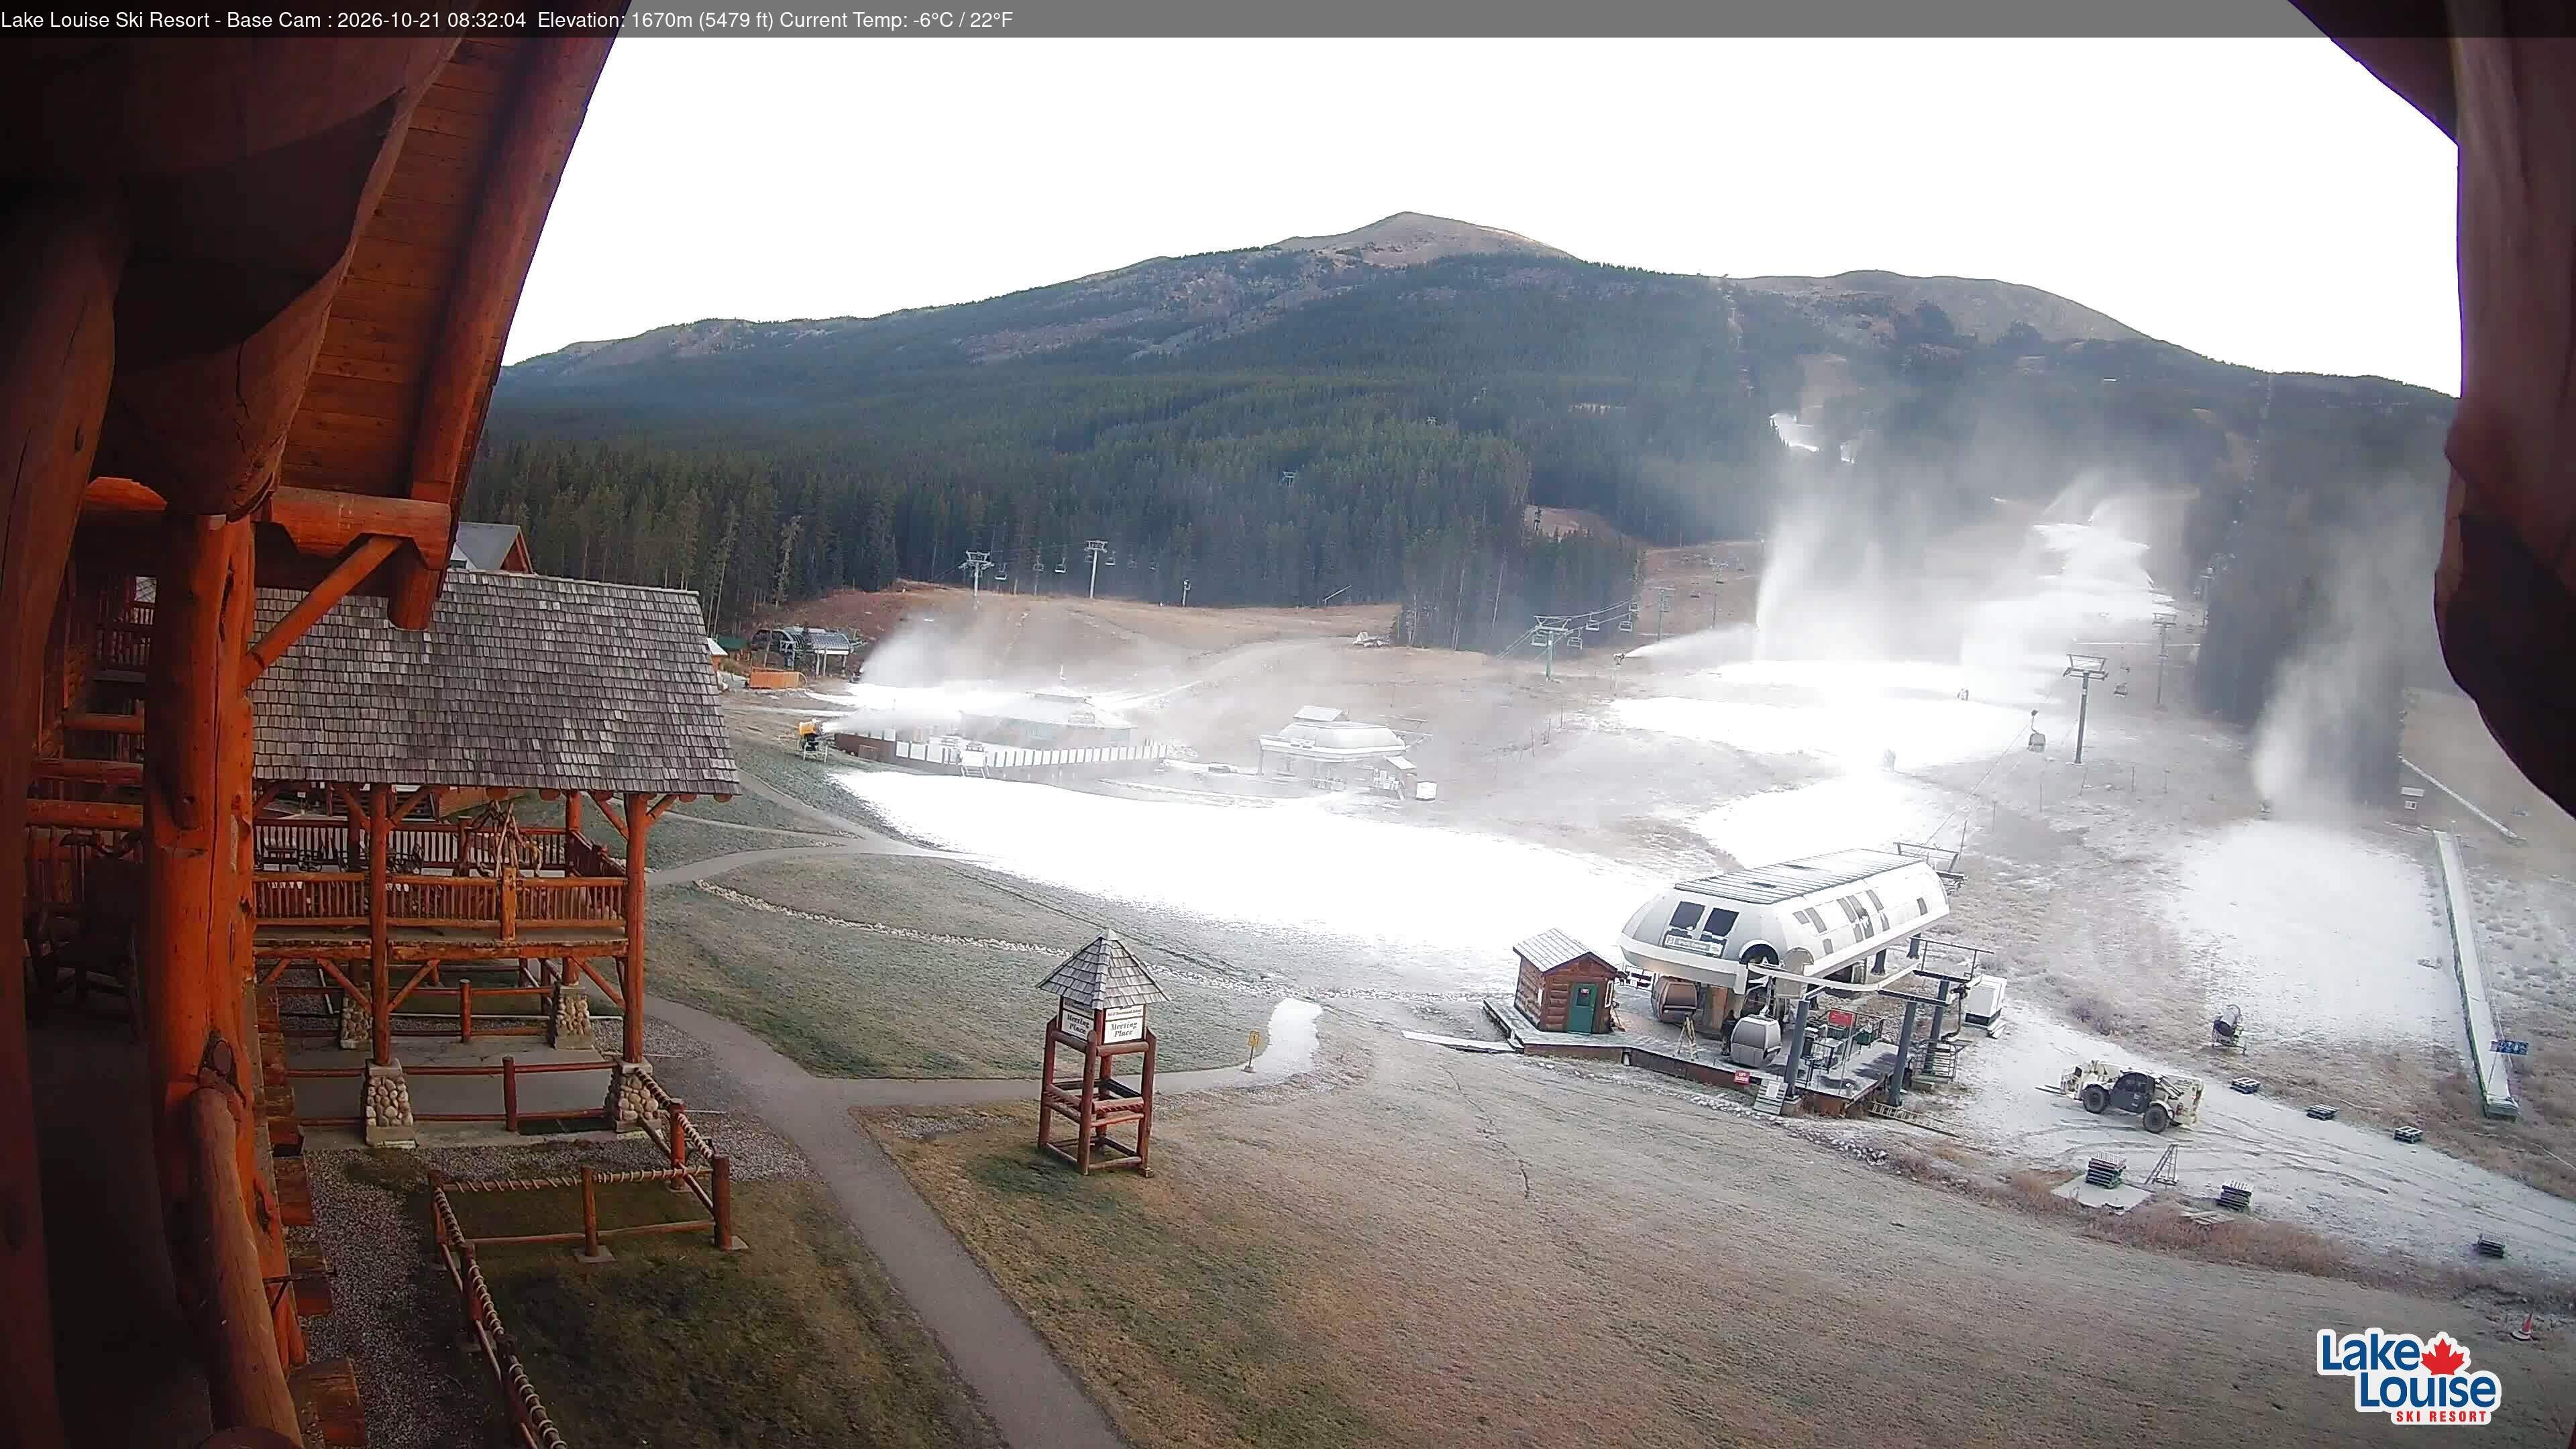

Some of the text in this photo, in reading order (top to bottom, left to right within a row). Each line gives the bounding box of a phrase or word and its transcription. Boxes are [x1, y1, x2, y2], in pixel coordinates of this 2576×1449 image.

[1067, 1014, 1090, 1029] Meeting
[1111, 1022, 1138, 1030] Meeting
[1069, 1023, 1087, 1034] Place
[1114, 1029, 1134, 1037] Place
